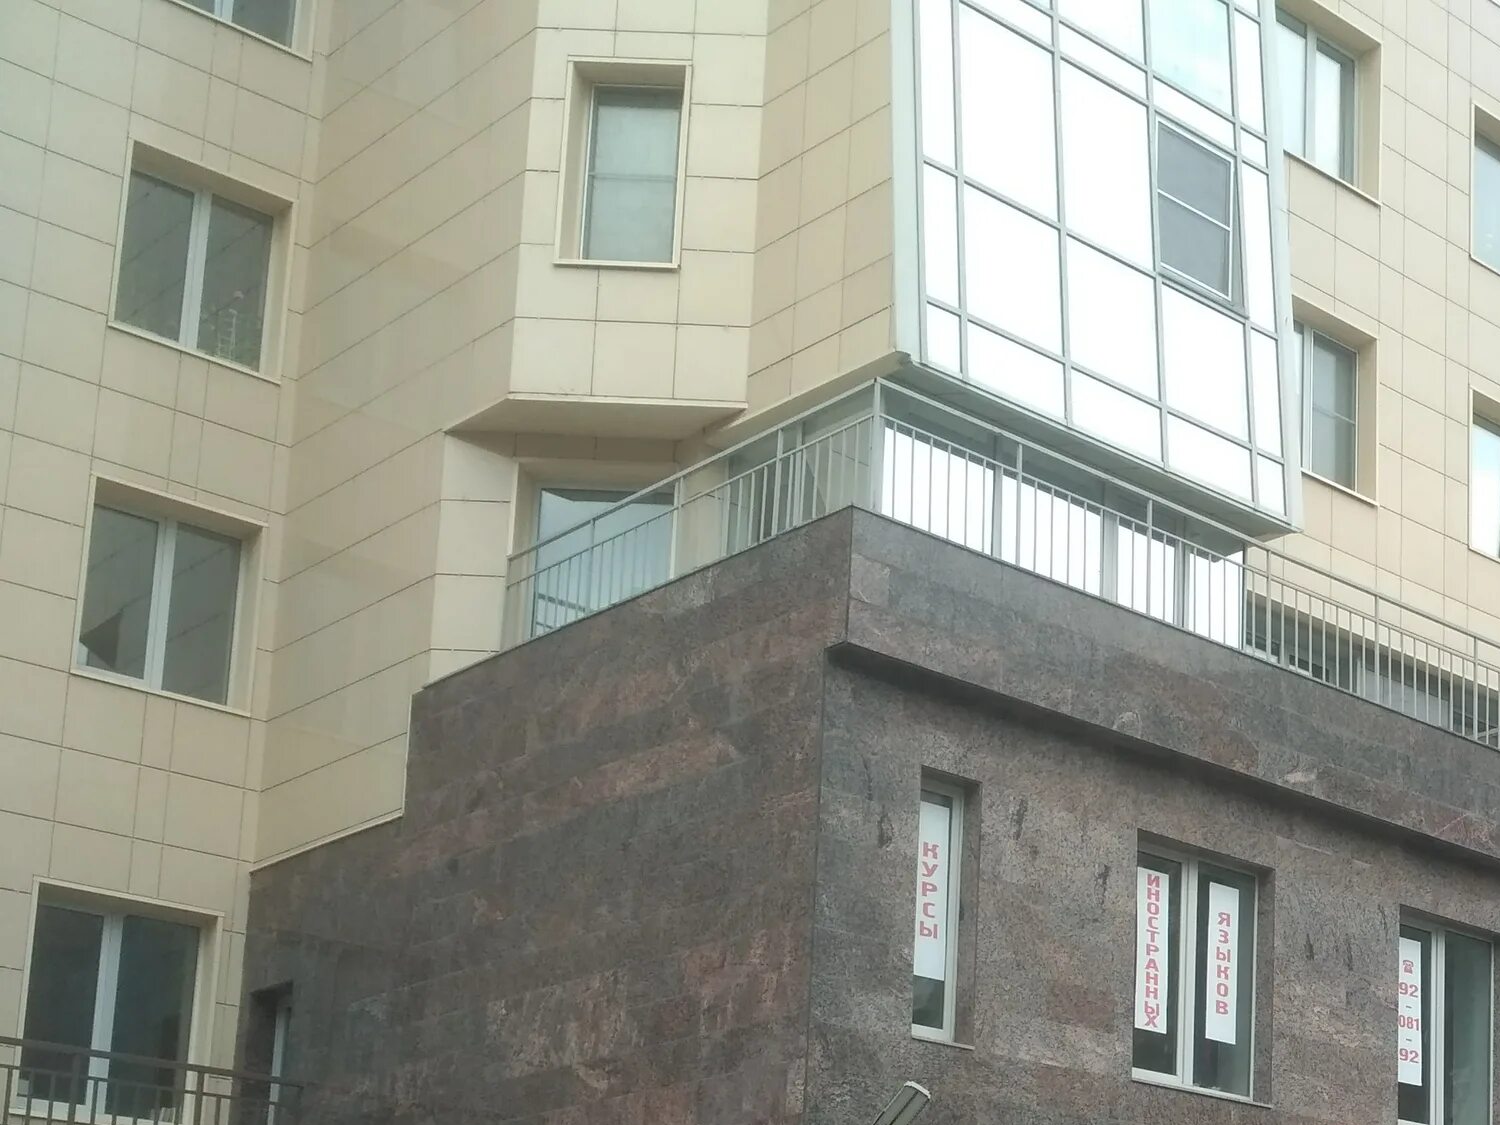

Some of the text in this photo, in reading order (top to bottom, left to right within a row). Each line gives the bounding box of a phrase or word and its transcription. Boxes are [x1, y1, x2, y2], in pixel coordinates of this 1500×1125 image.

[920, 841, 939, 940] КУРСЫ
[1144, 873, 1160, 1028] ИНОСТРАННЫХ
[1215, 911, 1231, 1016] ЯЗЫКОВ
